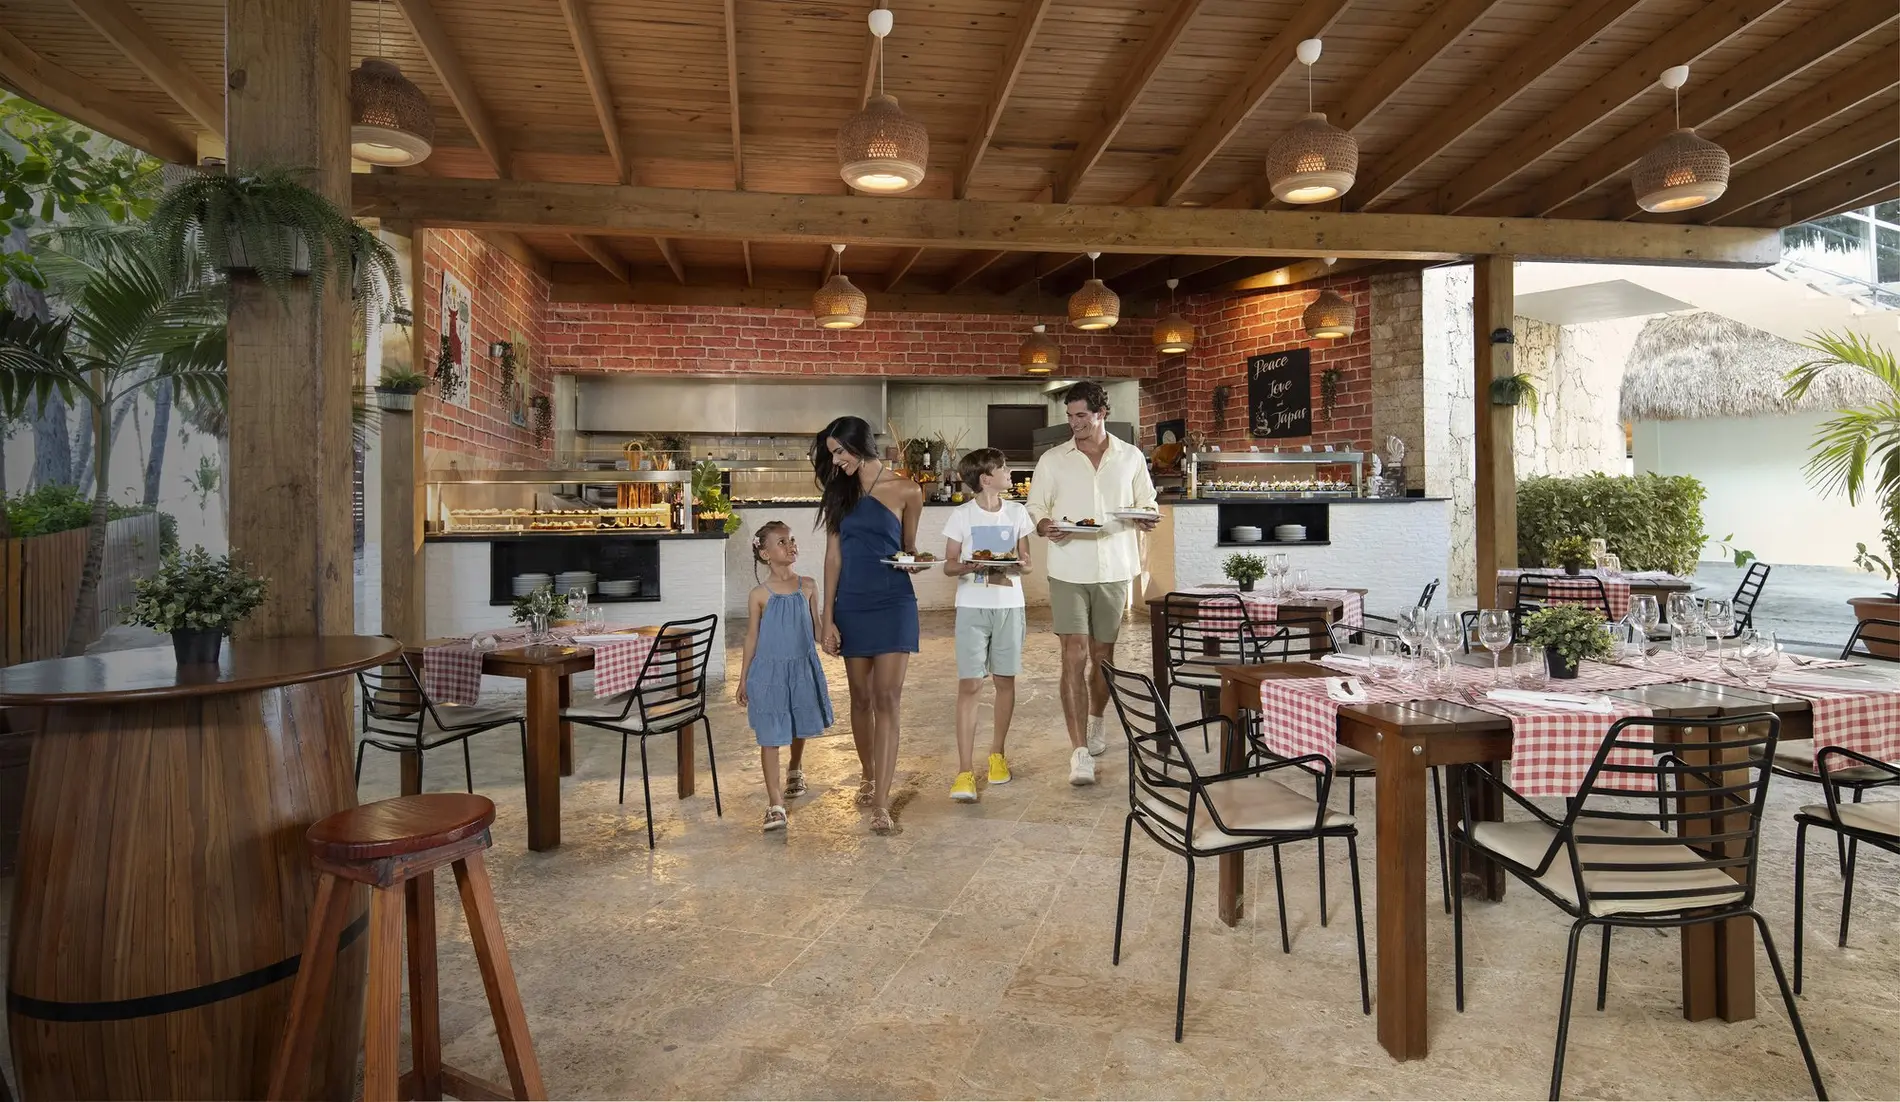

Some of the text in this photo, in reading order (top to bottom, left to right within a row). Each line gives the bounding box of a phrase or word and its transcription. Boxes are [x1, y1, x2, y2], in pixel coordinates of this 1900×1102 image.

[1253, 356, 1289, 380] Peace
[1267, 380, 1293, 399] Love
[1270, 407, 1307, 429] Tapas
